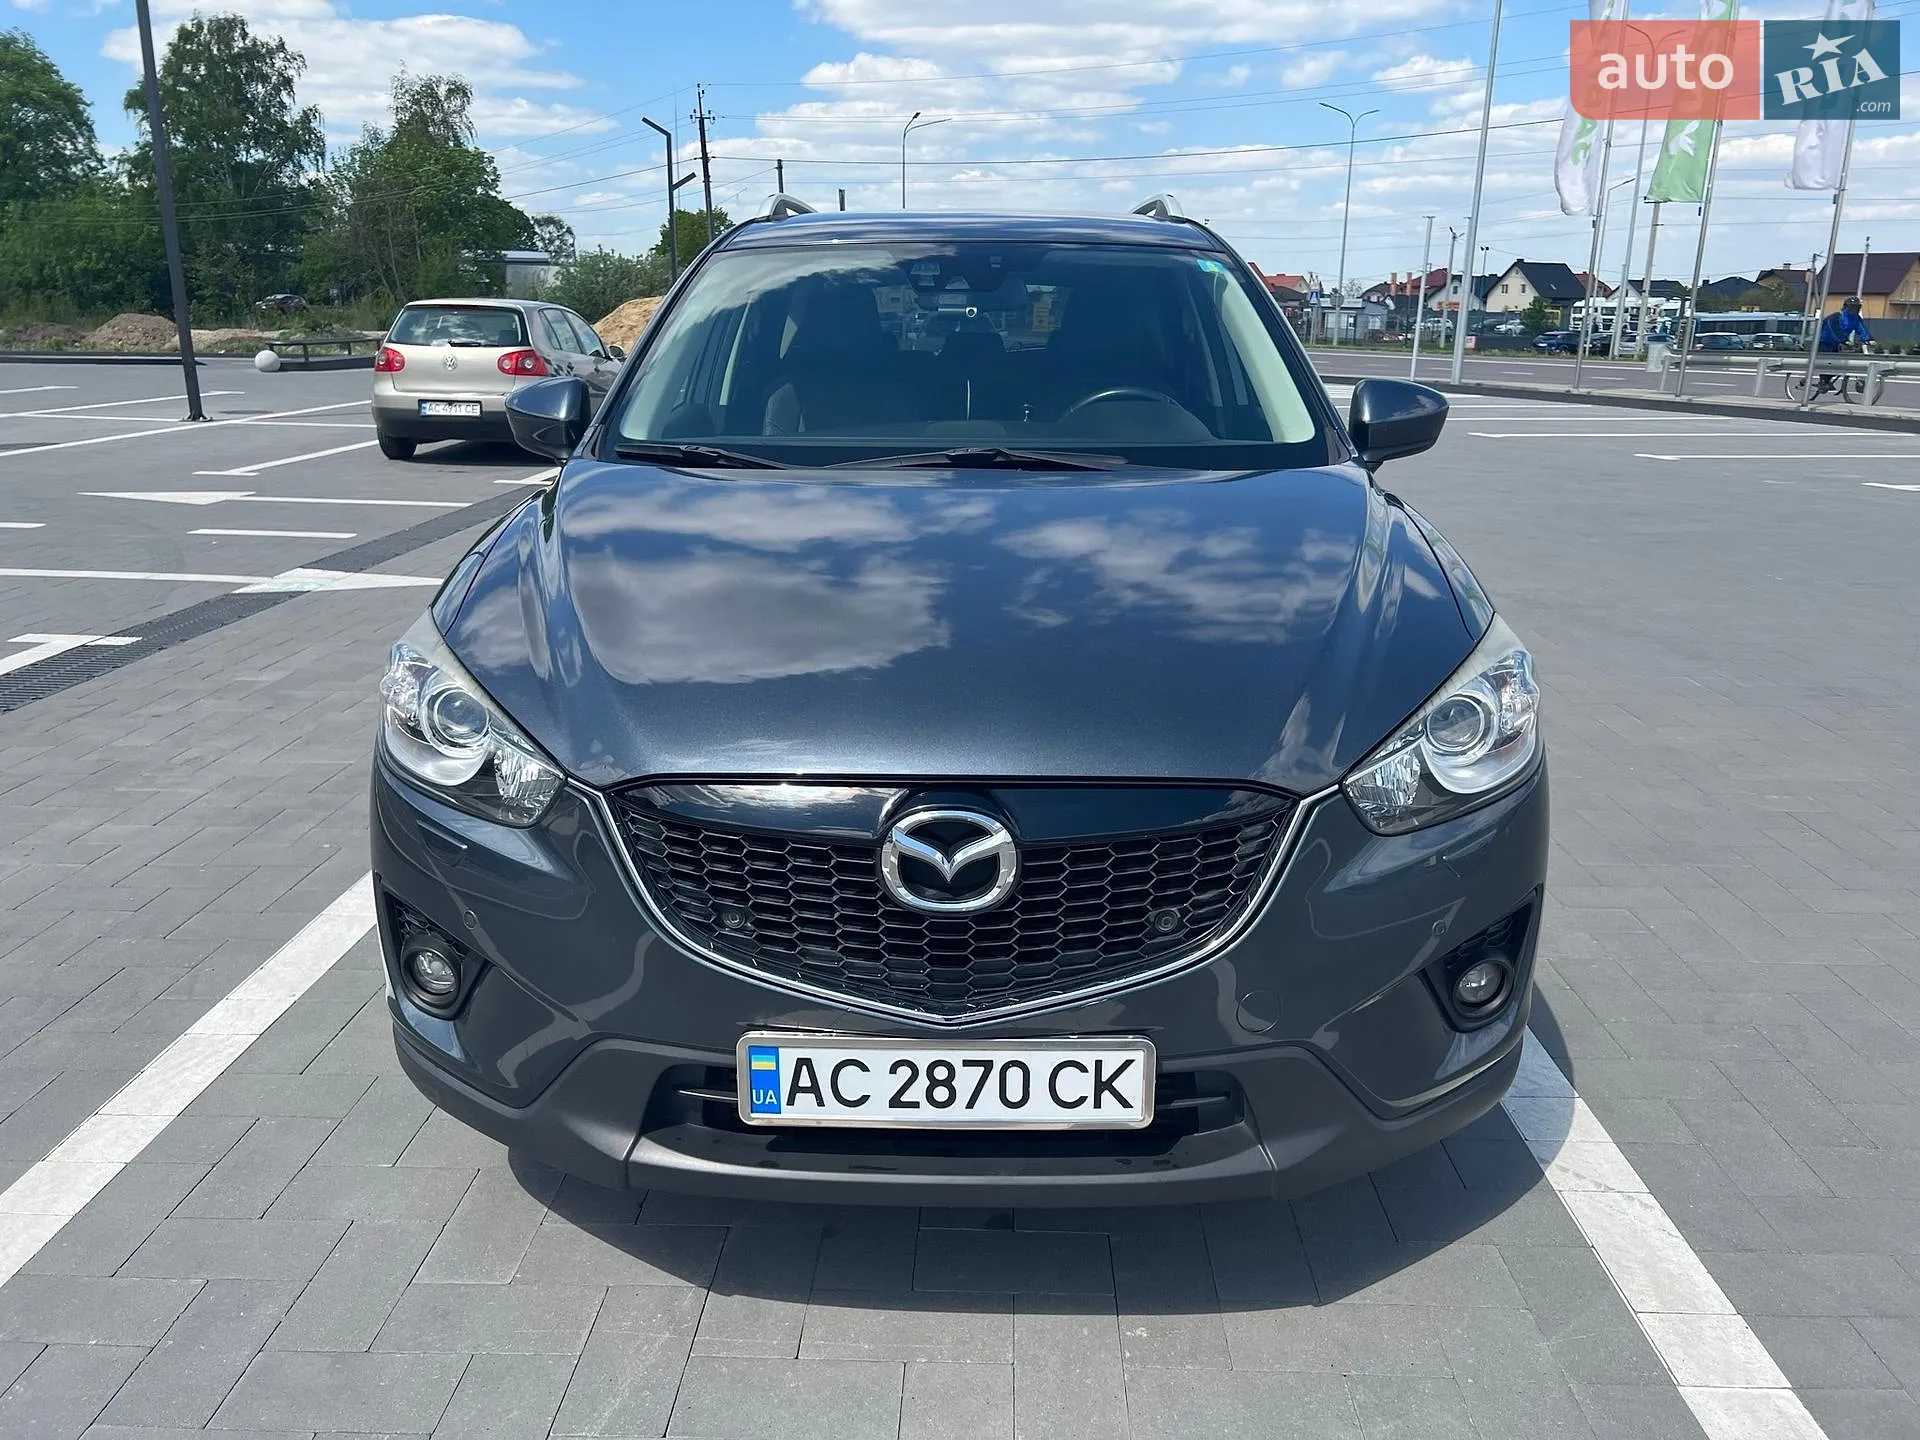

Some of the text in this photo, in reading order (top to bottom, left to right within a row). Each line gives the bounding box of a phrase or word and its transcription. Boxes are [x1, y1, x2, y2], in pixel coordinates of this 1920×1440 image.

[428, 402, 440, 413] AC
[465, 403, 479, 414] CE
[786, 1057, 1136, 1110] AC 2870 CK
[752, 1089, 777, 1105] UA
